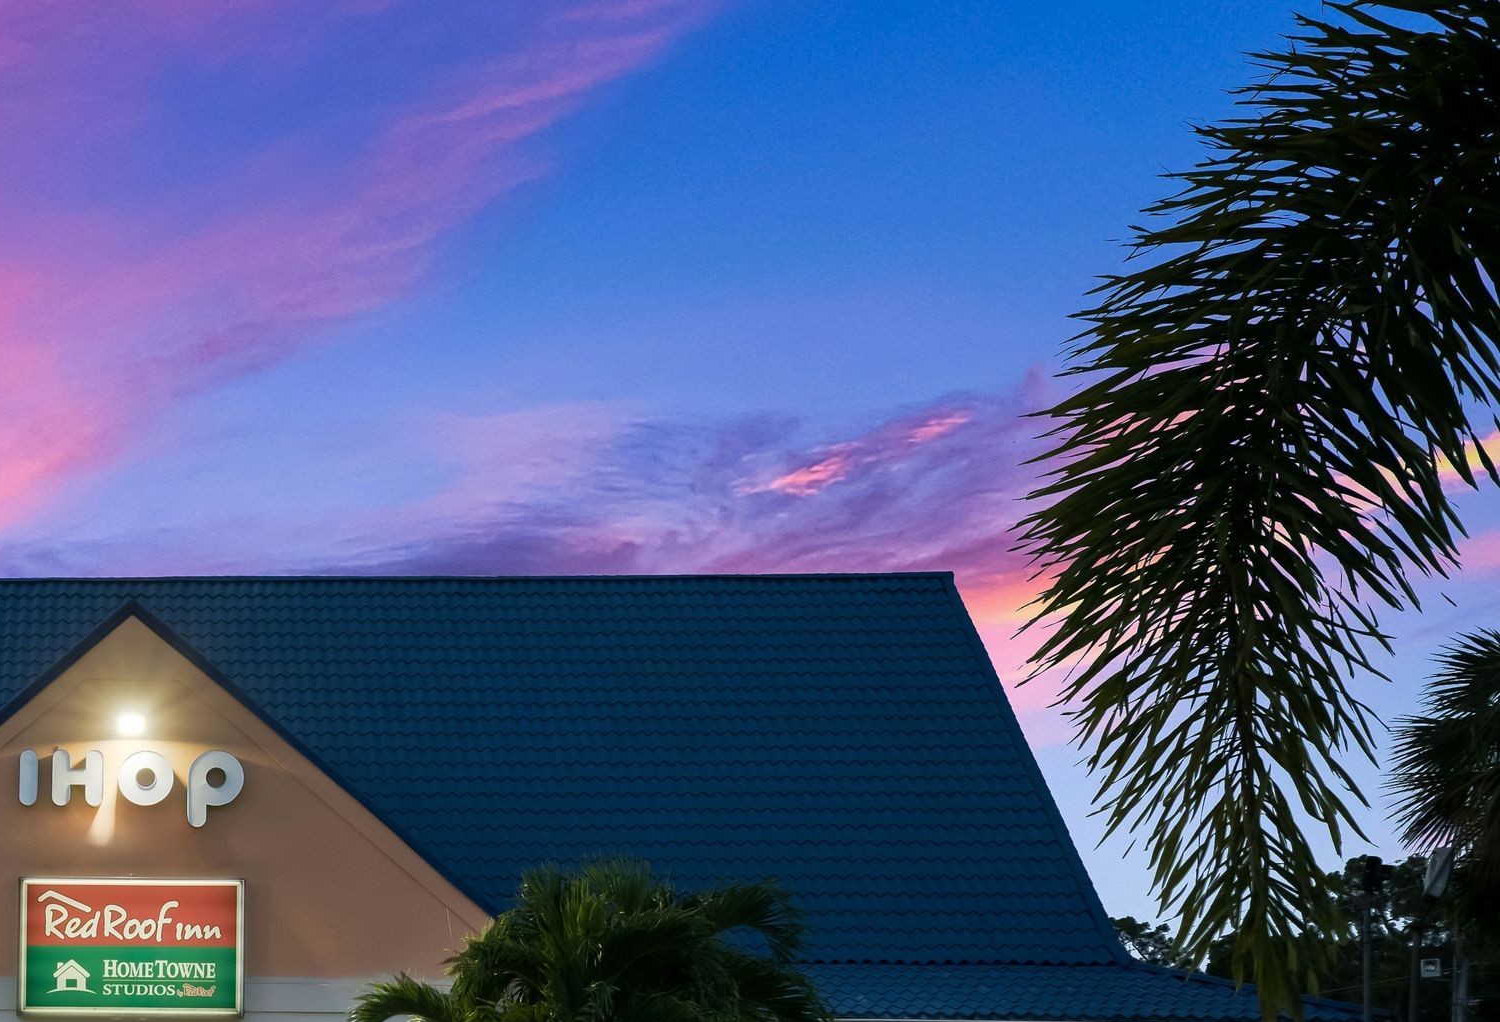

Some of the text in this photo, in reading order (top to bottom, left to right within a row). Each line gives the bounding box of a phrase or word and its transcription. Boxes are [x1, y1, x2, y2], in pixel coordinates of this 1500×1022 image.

[18, 749, 245, 828] IHOP
[44, 903, 101, 941] Red
[103, 901, 179, 942] Roof
[102, 984, 176, 996] STUDIOS
